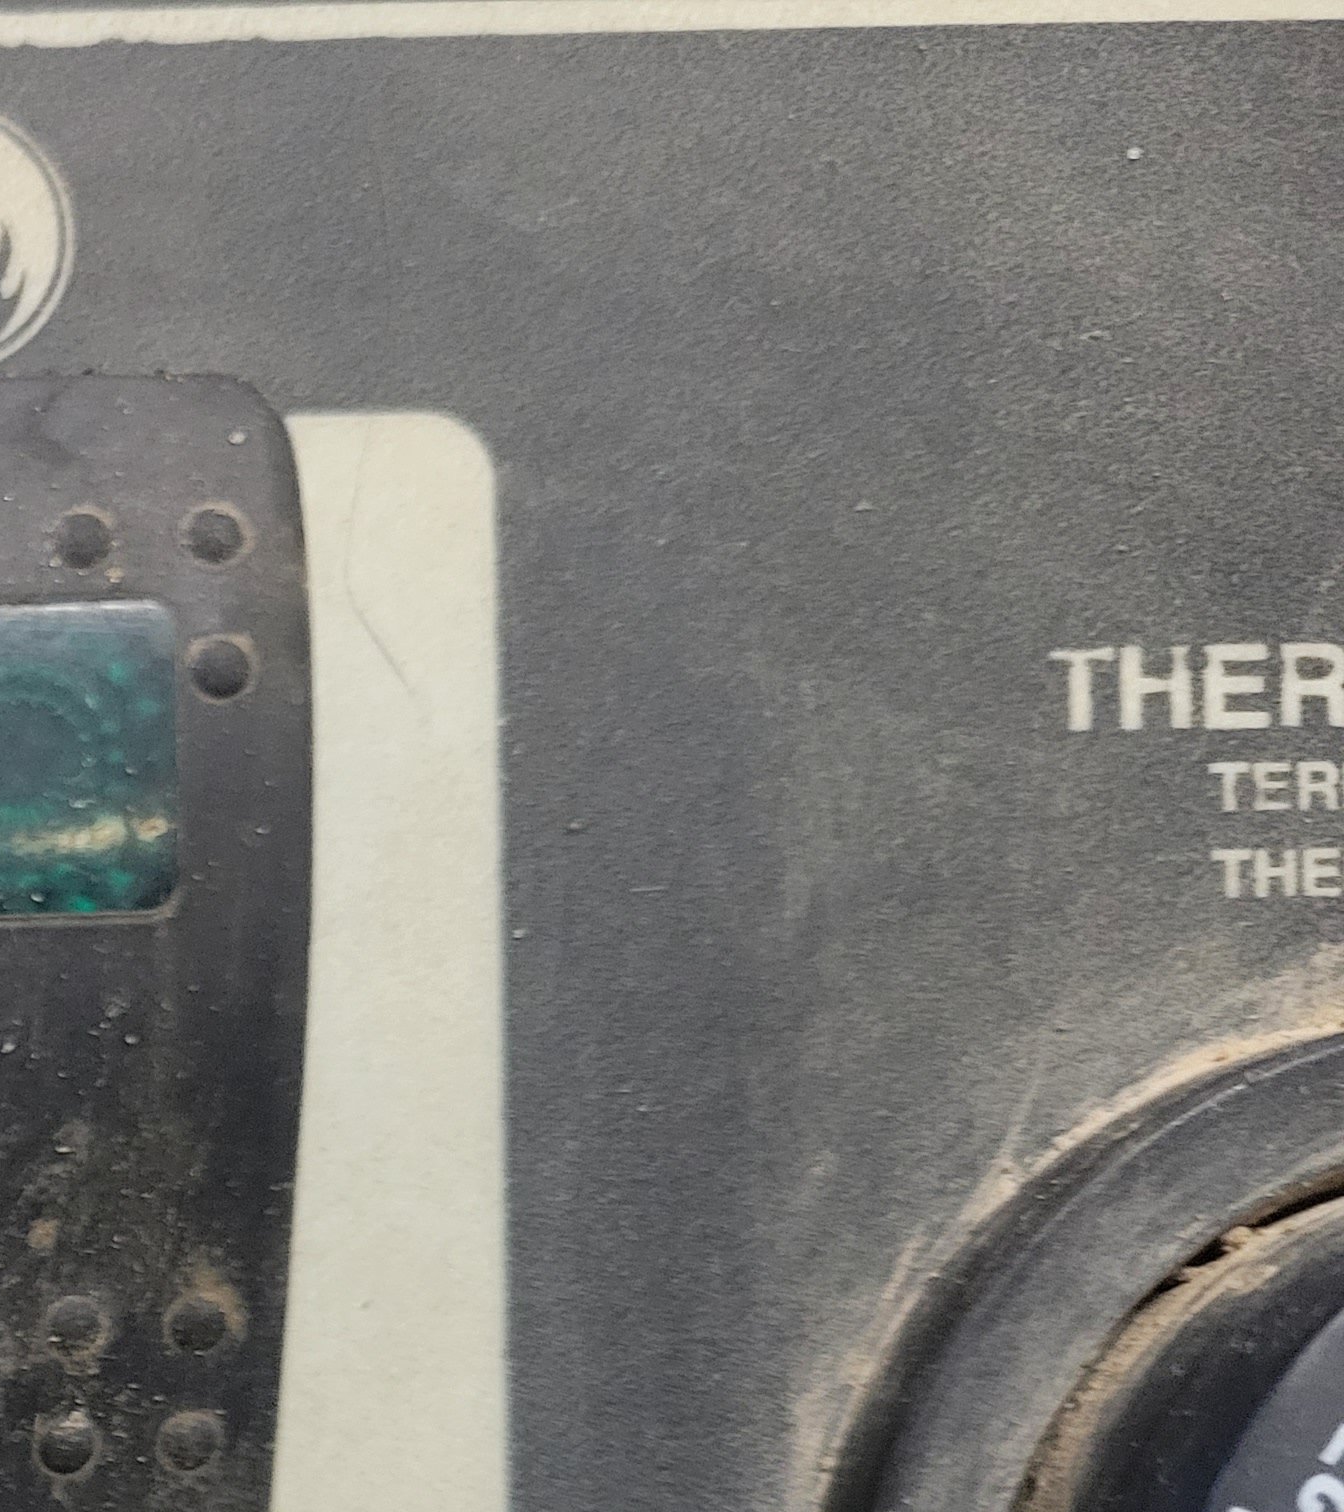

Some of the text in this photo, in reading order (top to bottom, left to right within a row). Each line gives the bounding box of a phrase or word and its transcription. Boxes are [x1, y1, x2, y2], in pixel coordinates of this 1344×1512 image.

[1048, 642, 1344, 731] THER
[1208, 761, 1344, 811] TER
[1212, 847, 1344, 898] THE
